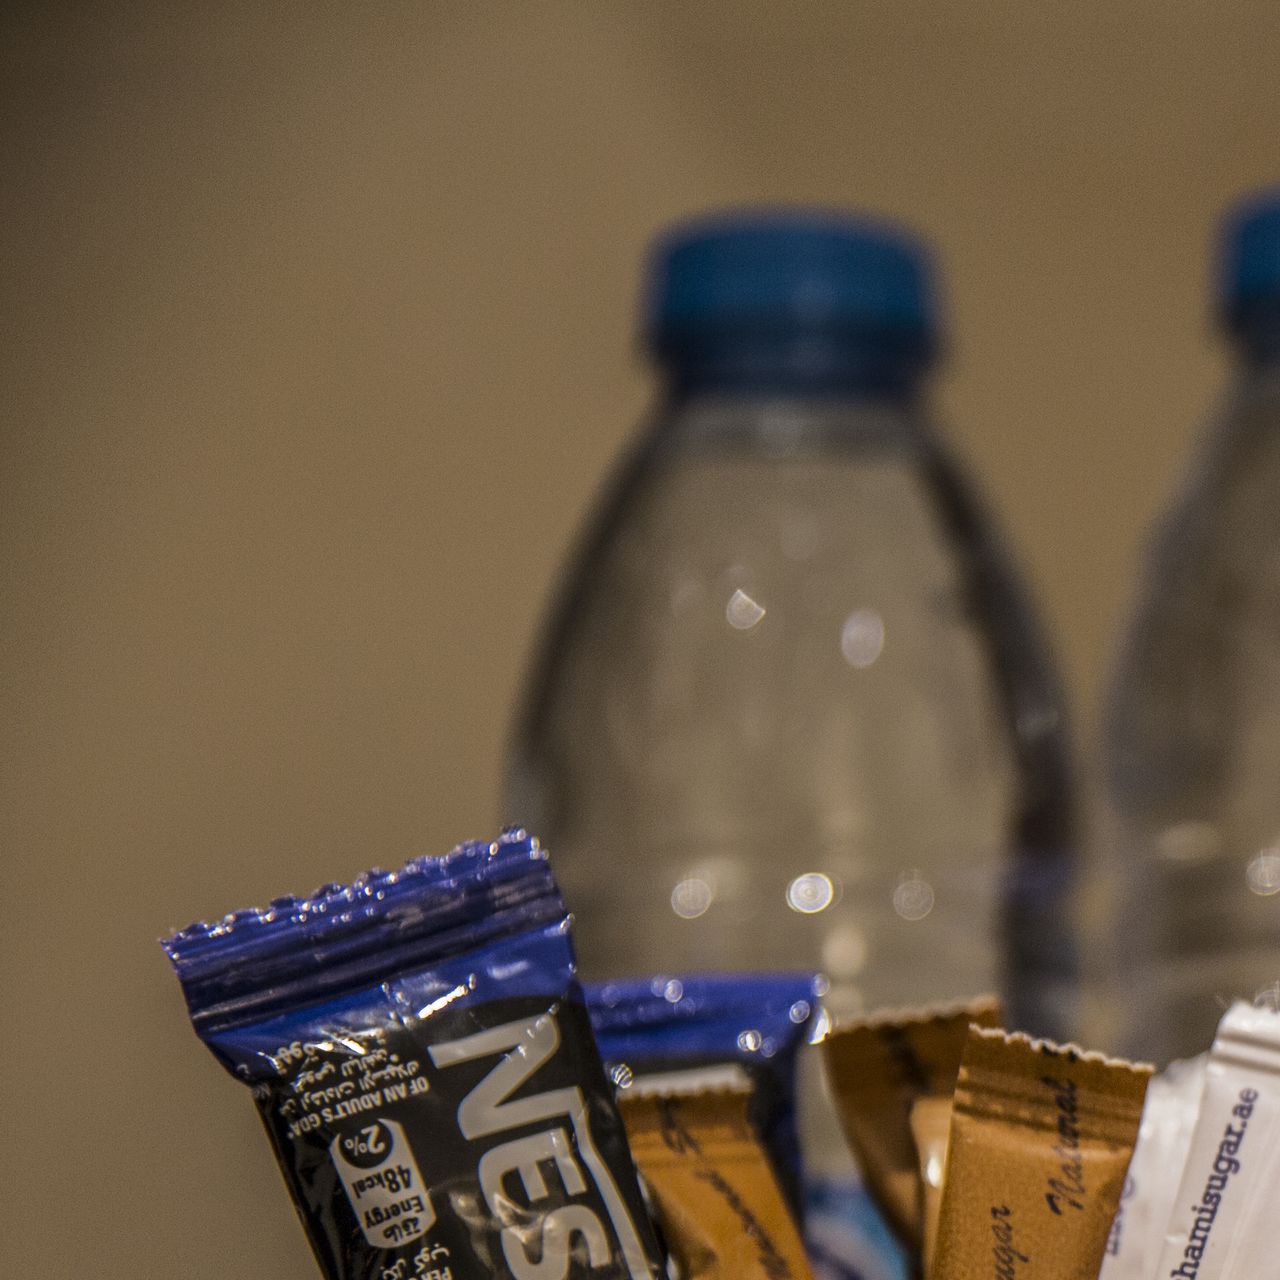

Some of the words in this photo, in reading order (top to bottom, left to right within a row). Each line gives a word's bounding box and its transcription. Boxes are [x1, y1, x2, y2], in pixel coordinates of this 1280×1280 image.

[383, 1084, 408, 1104] AN
[411, 1076, 430, 1095] OF
[344, 1124, 385, 1157] 2%
[364, 1195, 425, 1229] Energy
